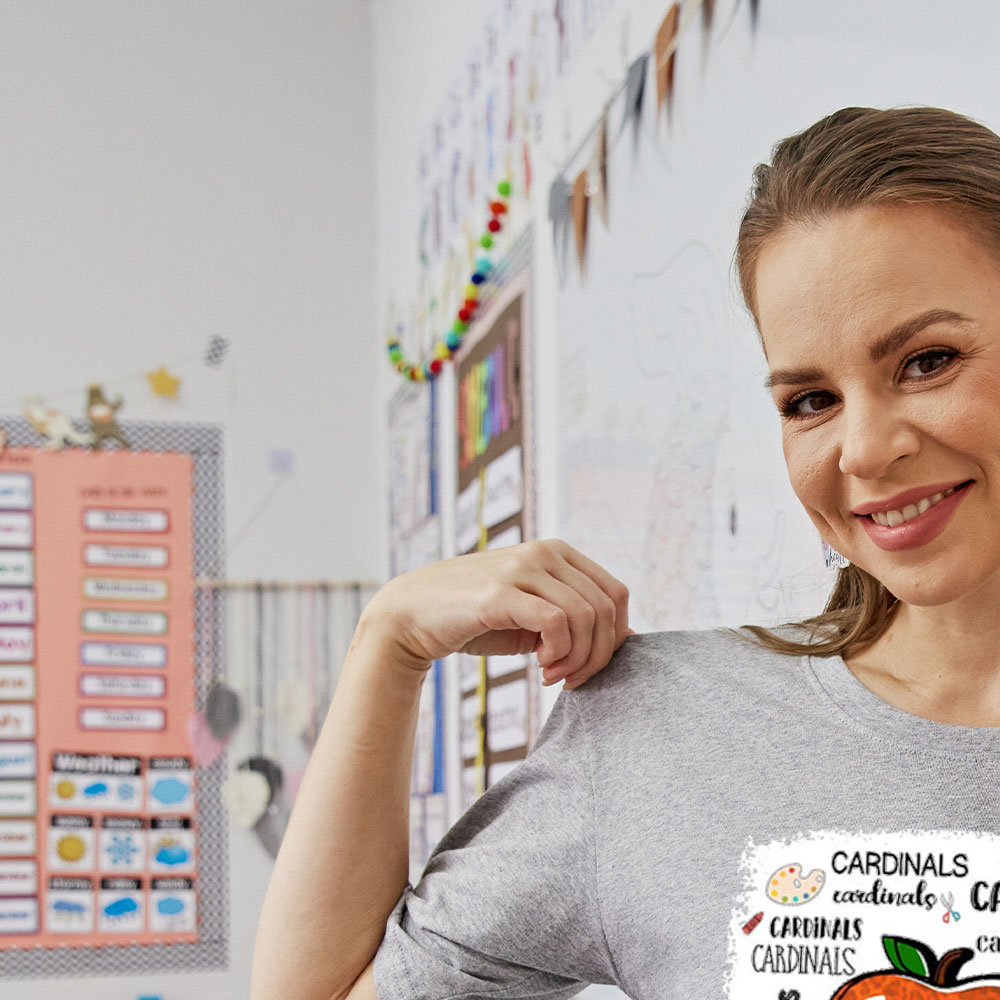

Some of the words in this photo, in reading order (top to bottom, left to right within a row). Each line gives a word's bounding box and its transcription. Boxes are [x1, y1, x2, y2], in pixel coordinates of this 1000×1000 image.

[831, 850, 969, 877] CARDINALS
[833, 879, 938, 911] cardinals
[752, 944, 856, 976] CARDINALS
